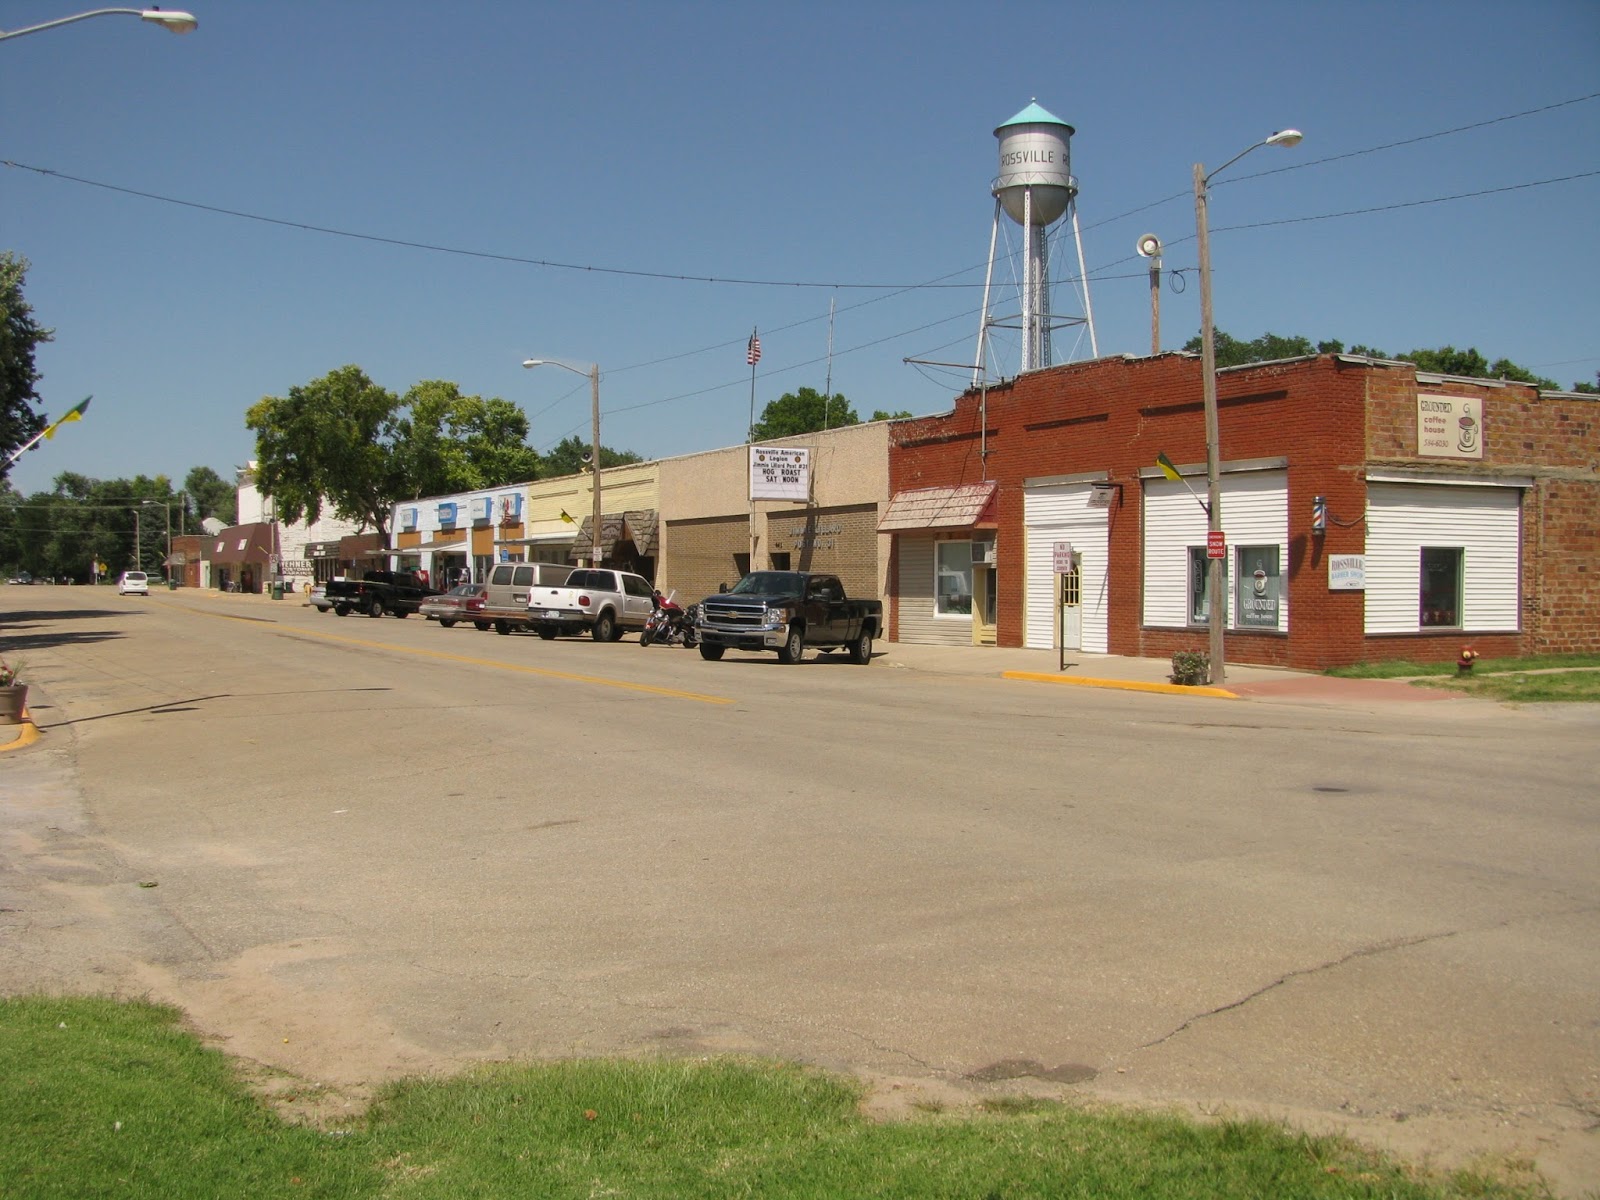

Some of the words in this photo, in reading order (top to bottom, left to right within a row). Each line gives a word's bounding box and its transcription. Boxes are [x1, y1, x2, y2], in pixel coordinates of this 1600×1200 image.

[1001, 150, 1055, 167] ROSSVILLE
[1421, 400, 1452, 413] GROUNDED
[1424, 416, 1446, 424] coffee
[1331, 557, 1363, 571] ROSSVILLE
[1243, 599, 1276, 611] GROUNDED
